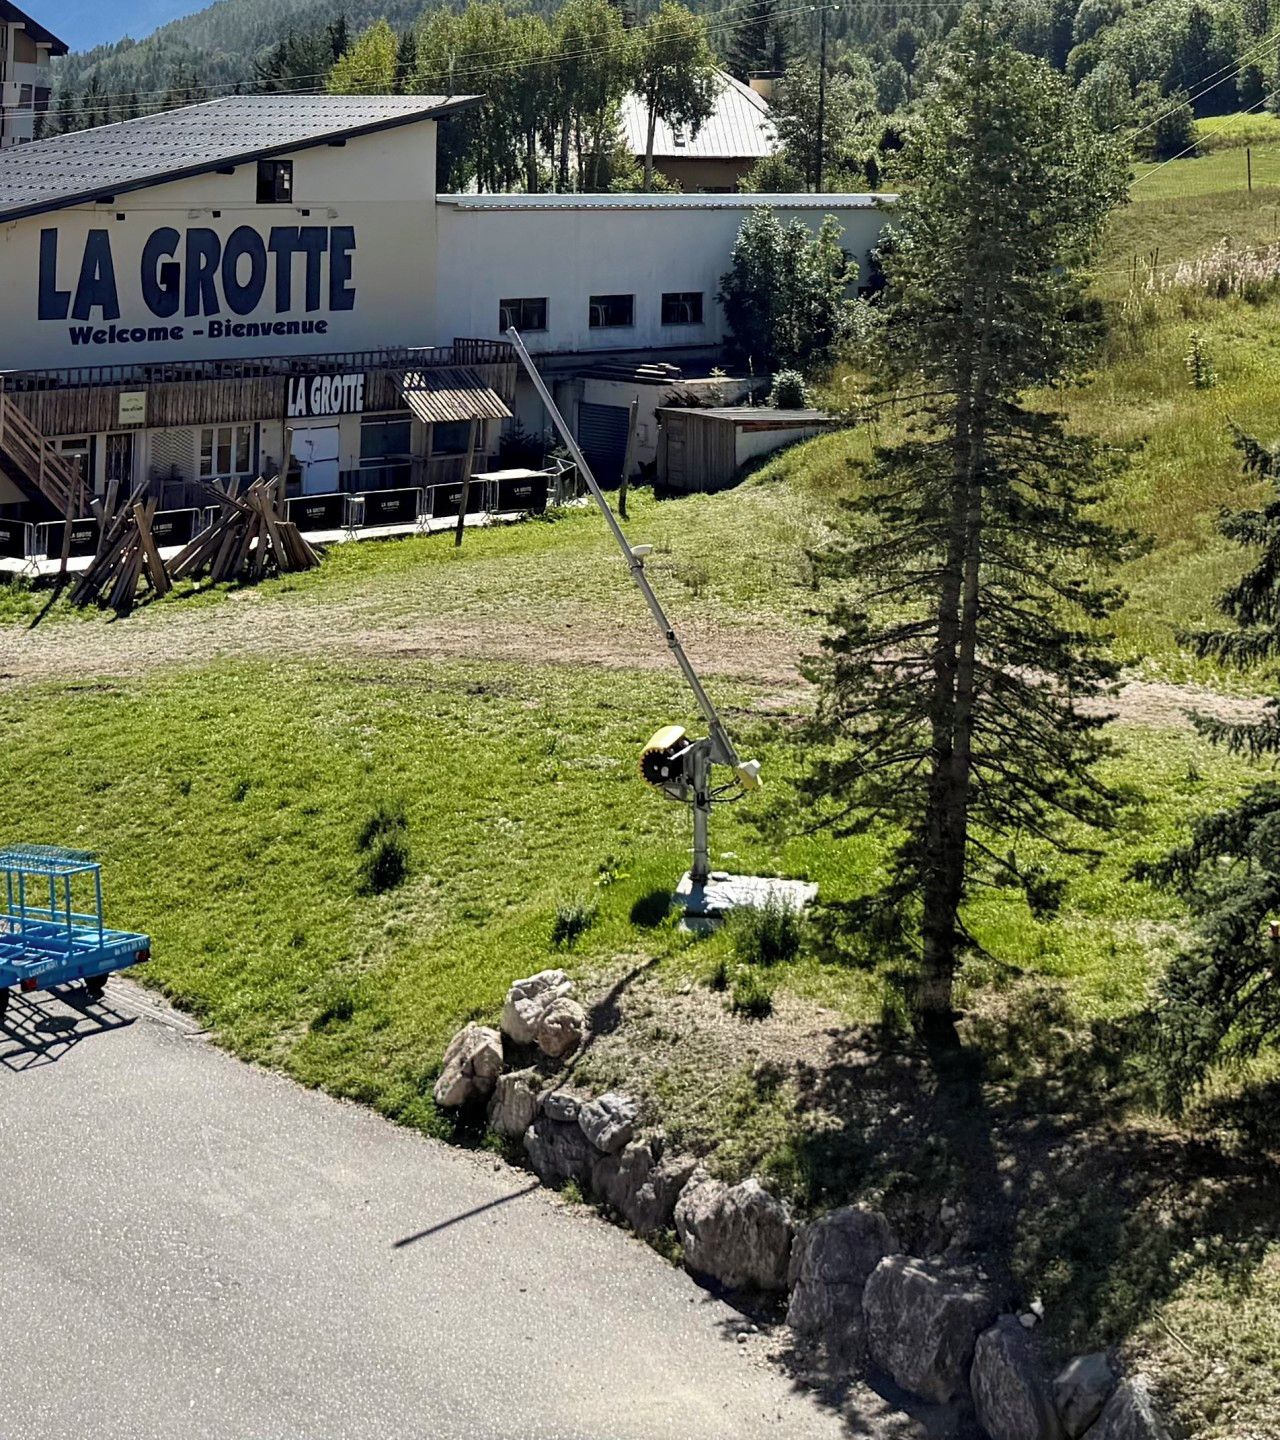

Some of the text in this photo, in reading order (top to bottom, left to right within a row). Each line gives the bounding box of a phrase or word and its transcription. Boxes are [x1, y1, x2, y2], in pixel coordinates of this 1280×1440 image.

[38, 225, 356, 320] LA GROTTE
[69, 324, 184, 345] Welcome
[208, 319, 328, 338] Bienvenue
[287, 373, 365, 417] LA GROTTE
